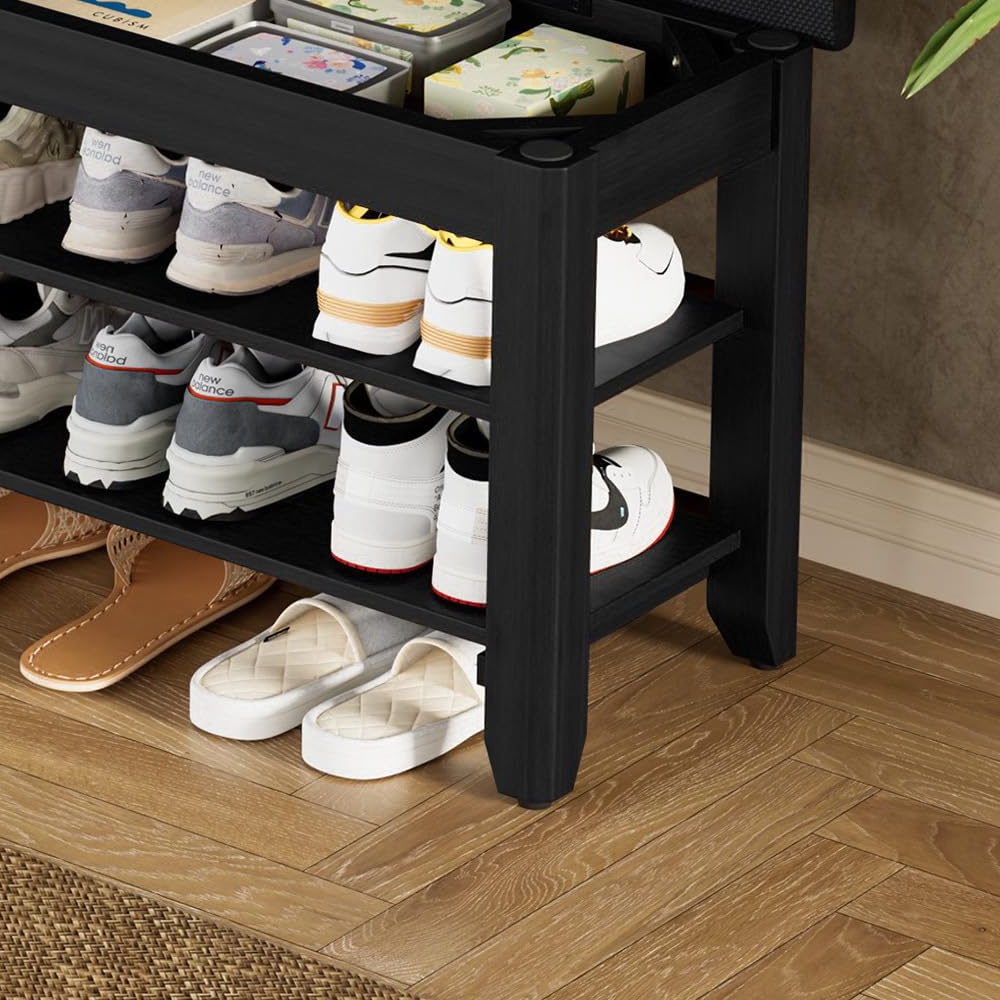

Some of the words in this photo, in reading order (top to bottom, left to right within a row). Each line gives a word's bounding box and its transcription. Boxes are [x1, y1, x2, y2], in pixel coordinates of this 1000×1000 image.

[92, 11, 150, 31] CUBISM
[199, 170, 222, 183] new
[199, 373, 222, 385] new
